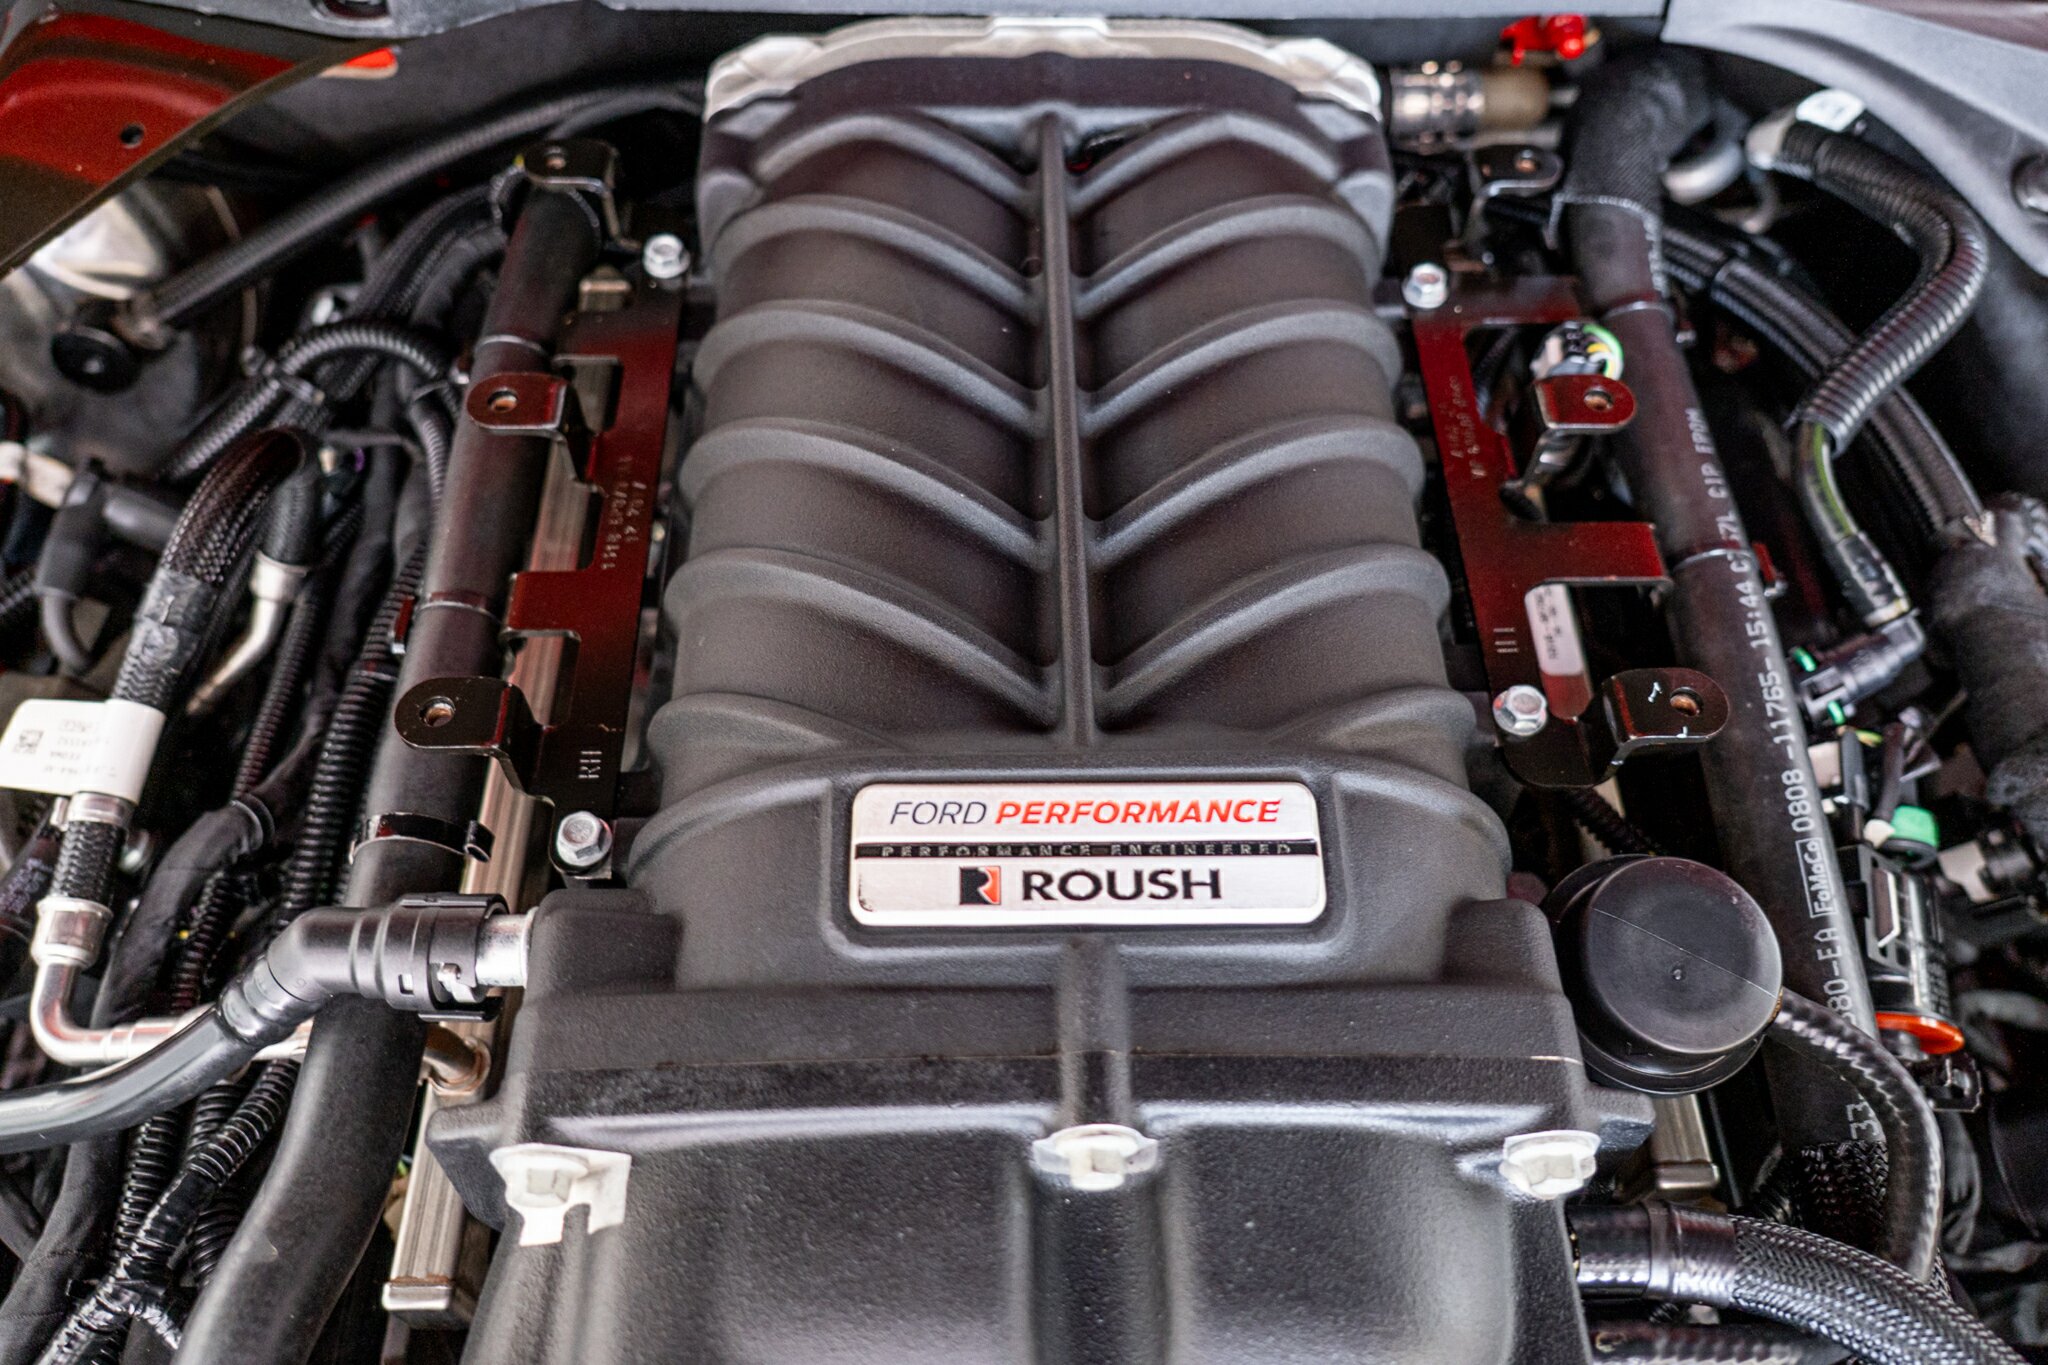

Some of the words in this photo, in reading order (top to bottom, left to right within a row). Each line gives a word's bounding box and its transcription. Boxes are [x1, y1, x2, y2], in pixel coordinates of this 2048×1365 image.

[1734, 580, 1773, 649] 15:44
[577, 750, 603, 779] RH
[890, 800, 987, 825] FORD
[995, 799, 1282, 825] PERFORMANCE
[1781, 768, 1815, 832] 0808
[881, 844, 1091, 857] PERFORMANCE
[1110, 843, 1291, 856] ENGINEERED
[1022, 868, 1222, 901] ROUSH
[1803, 839, 1833, 914] FoMoCo
